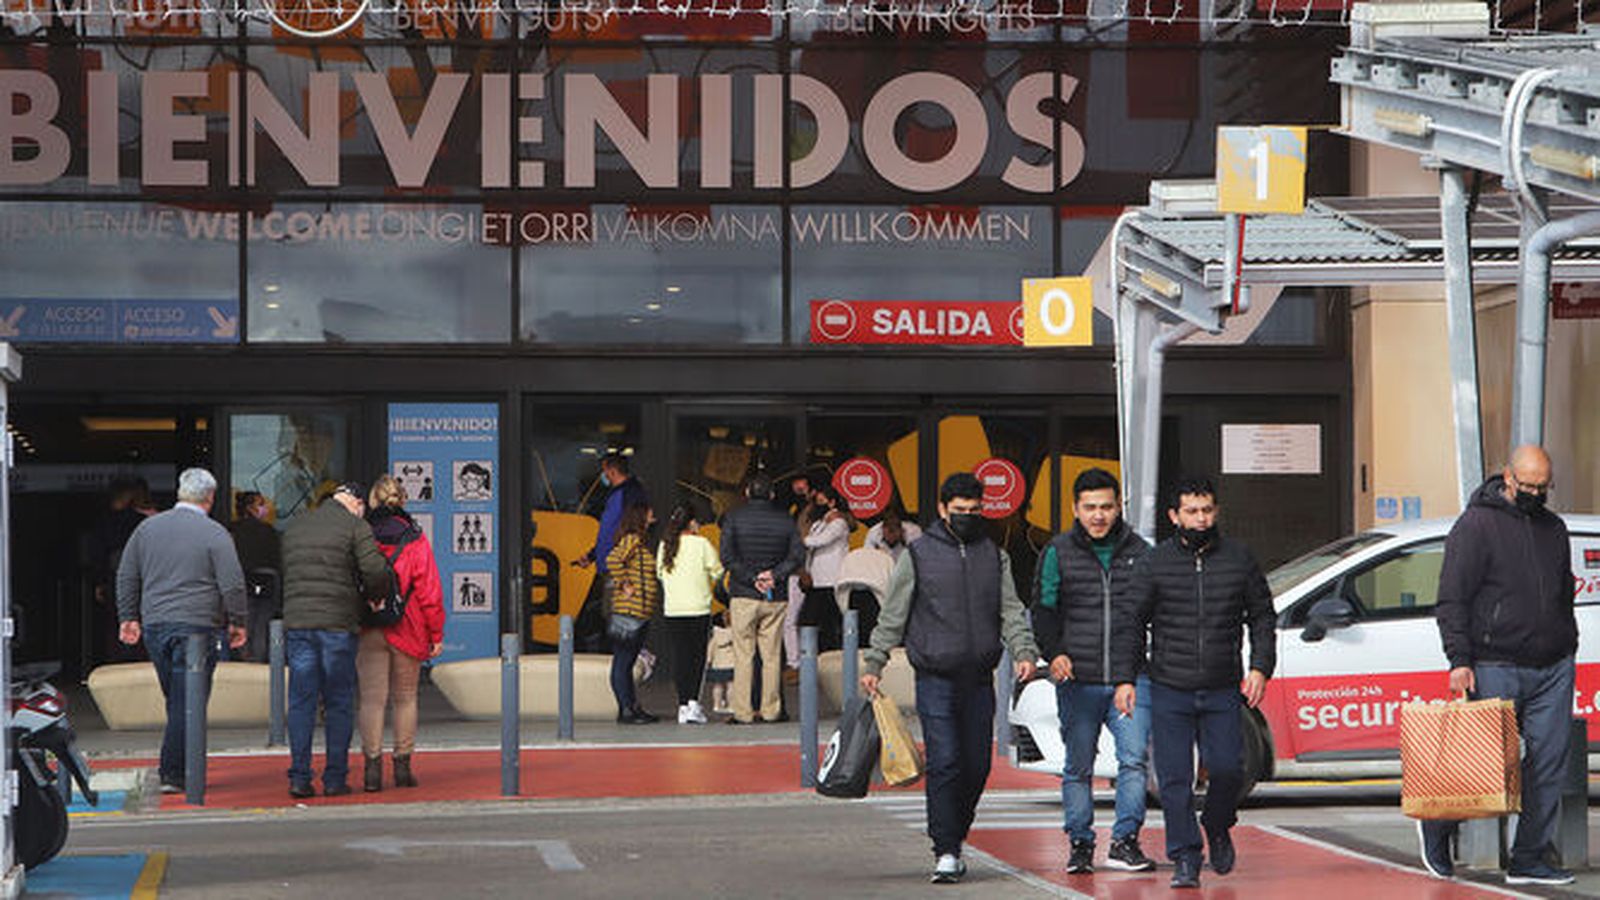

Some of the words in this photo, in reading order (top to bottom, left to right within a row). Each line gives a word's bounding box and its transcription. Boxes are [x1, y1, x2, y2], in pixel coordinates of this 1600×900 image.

[0, 71, 1085, 192] BIENVENIDOS
[1249, 142, 1271, 200] 1
[183, 210, 371, 241] WELCOME
[602, 207, 781, 242] VÄLKOMNA
[791, 212, 1030, 242] WILLKOMMEN
[45, 306, 105, 322] ACCESO
[124, 307, 185, 322] ACCESO
[872, 309, 993, 336] SALIDA
[1040, 288, 1075, 336] 0
[1297, 686, 1359, 699] Protección
[1361, 686, 1383, 697] 24h
